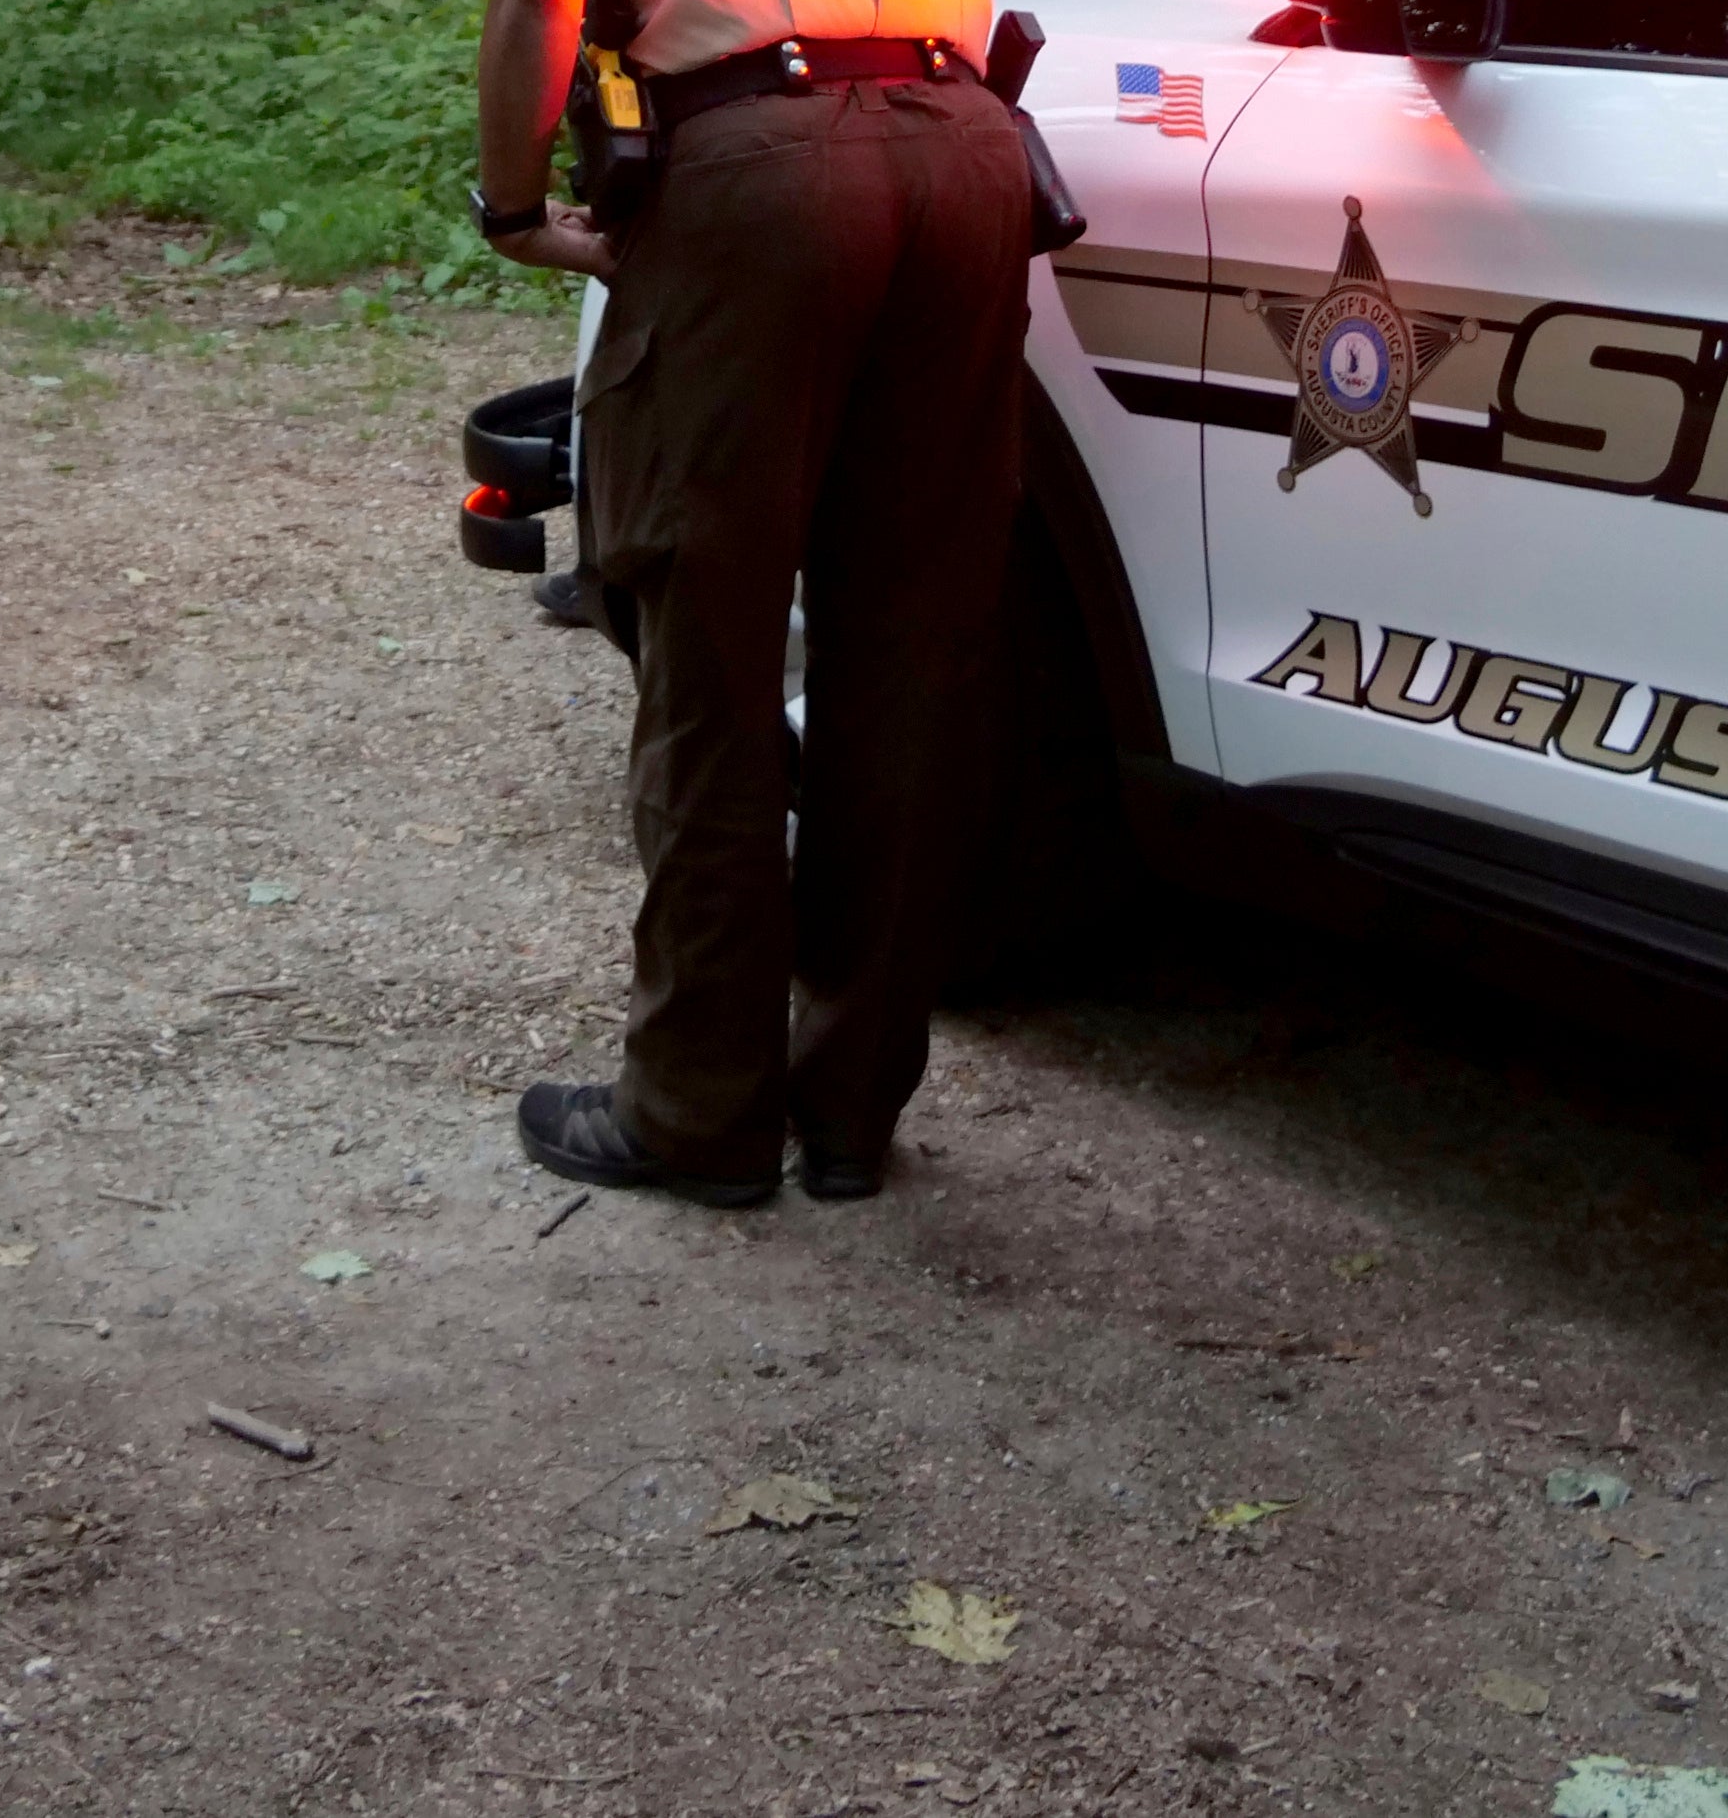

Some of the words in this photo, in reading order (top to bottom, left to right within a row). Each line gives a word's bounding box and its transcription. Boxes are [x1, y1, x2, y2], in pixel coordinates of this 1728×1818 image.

[1306, 295, 1368, 352] SHERIFF'S
[1370, 304, 1405, 364] OFFICE
[1306, 369, 1355, 432] AUGUSTA
[1358, 381, 1403, 433] COUNTY
